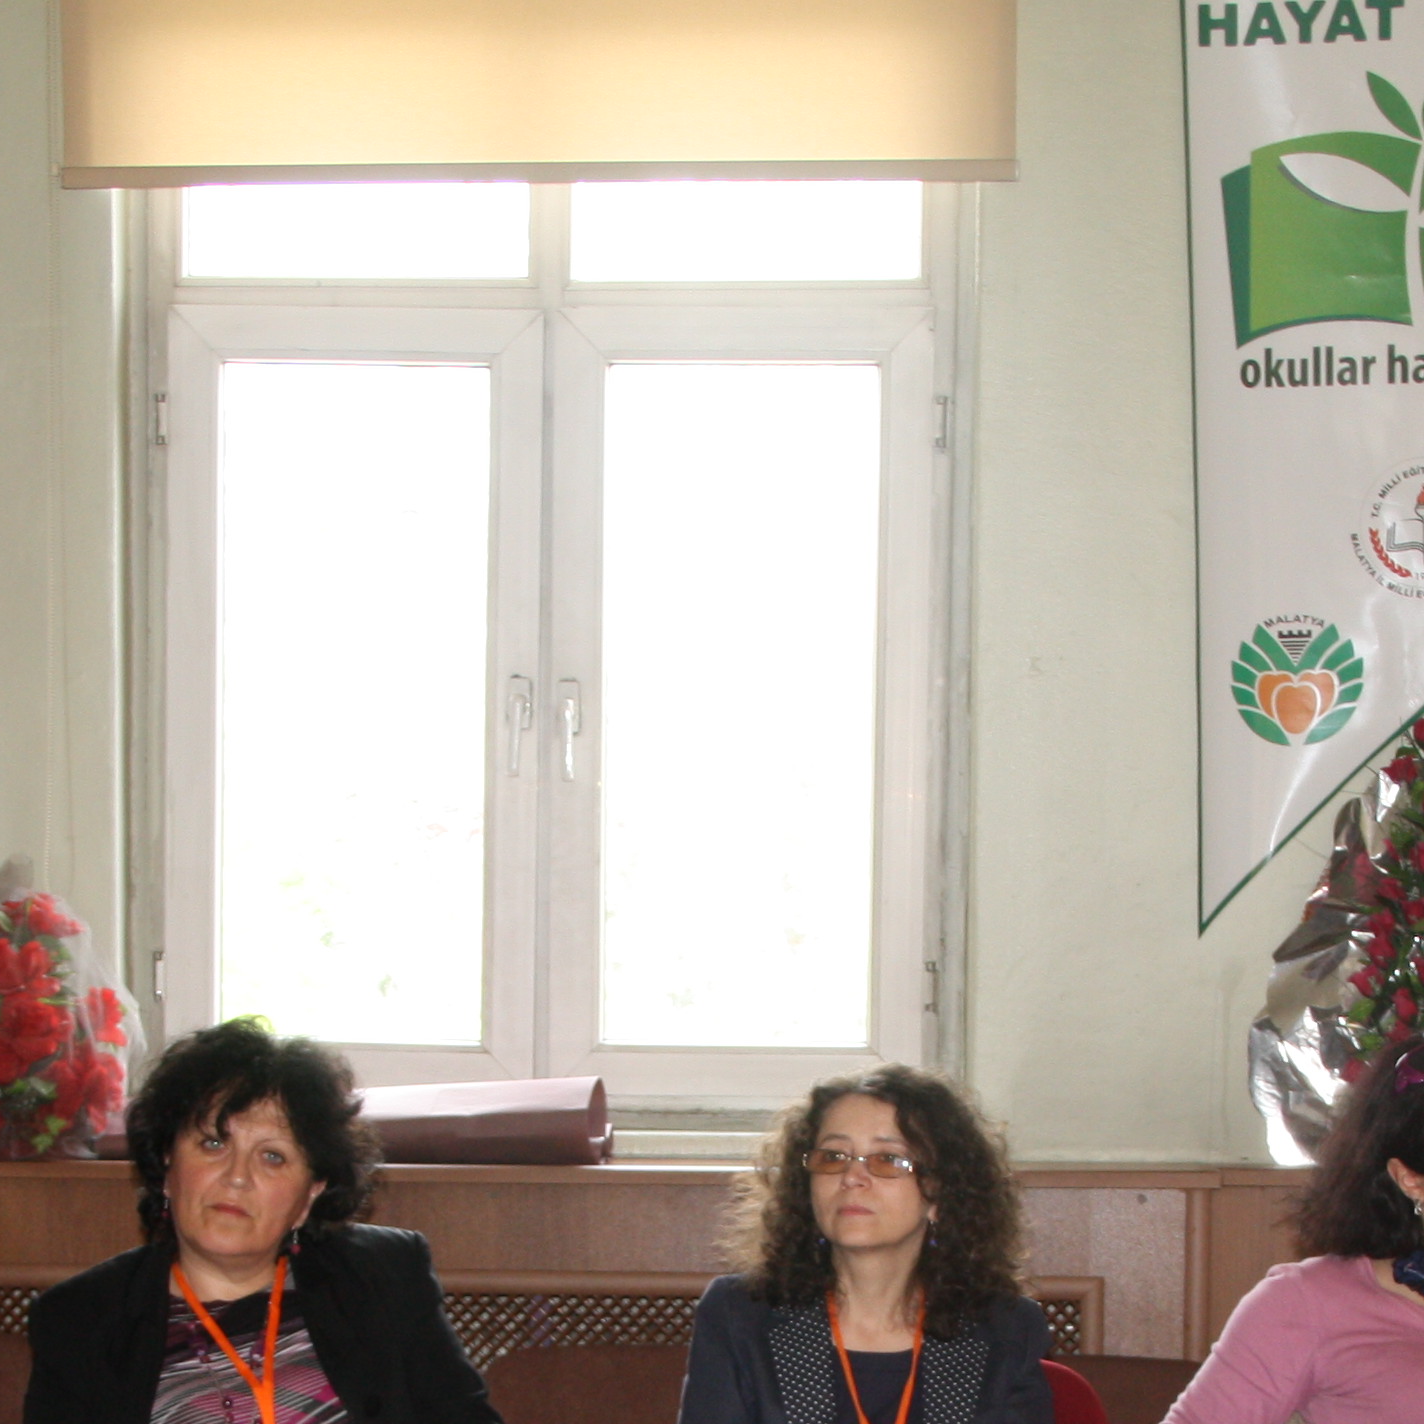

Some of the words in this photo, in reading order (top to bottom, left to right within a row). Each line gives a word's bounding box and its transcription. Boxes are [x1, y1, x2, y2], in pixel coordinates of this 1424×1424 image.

[1198, 0, 1405, 47] HAYAT
[1240, 346, 1376, 389] okullar
[1378, 473, 1402, 499] MİLLİ
[1350, 533, 1377, 577] MALATYA
[1386, 581, 1414, 598] MİLLİ
[1263, 614, 1326, 628] MALATYA
